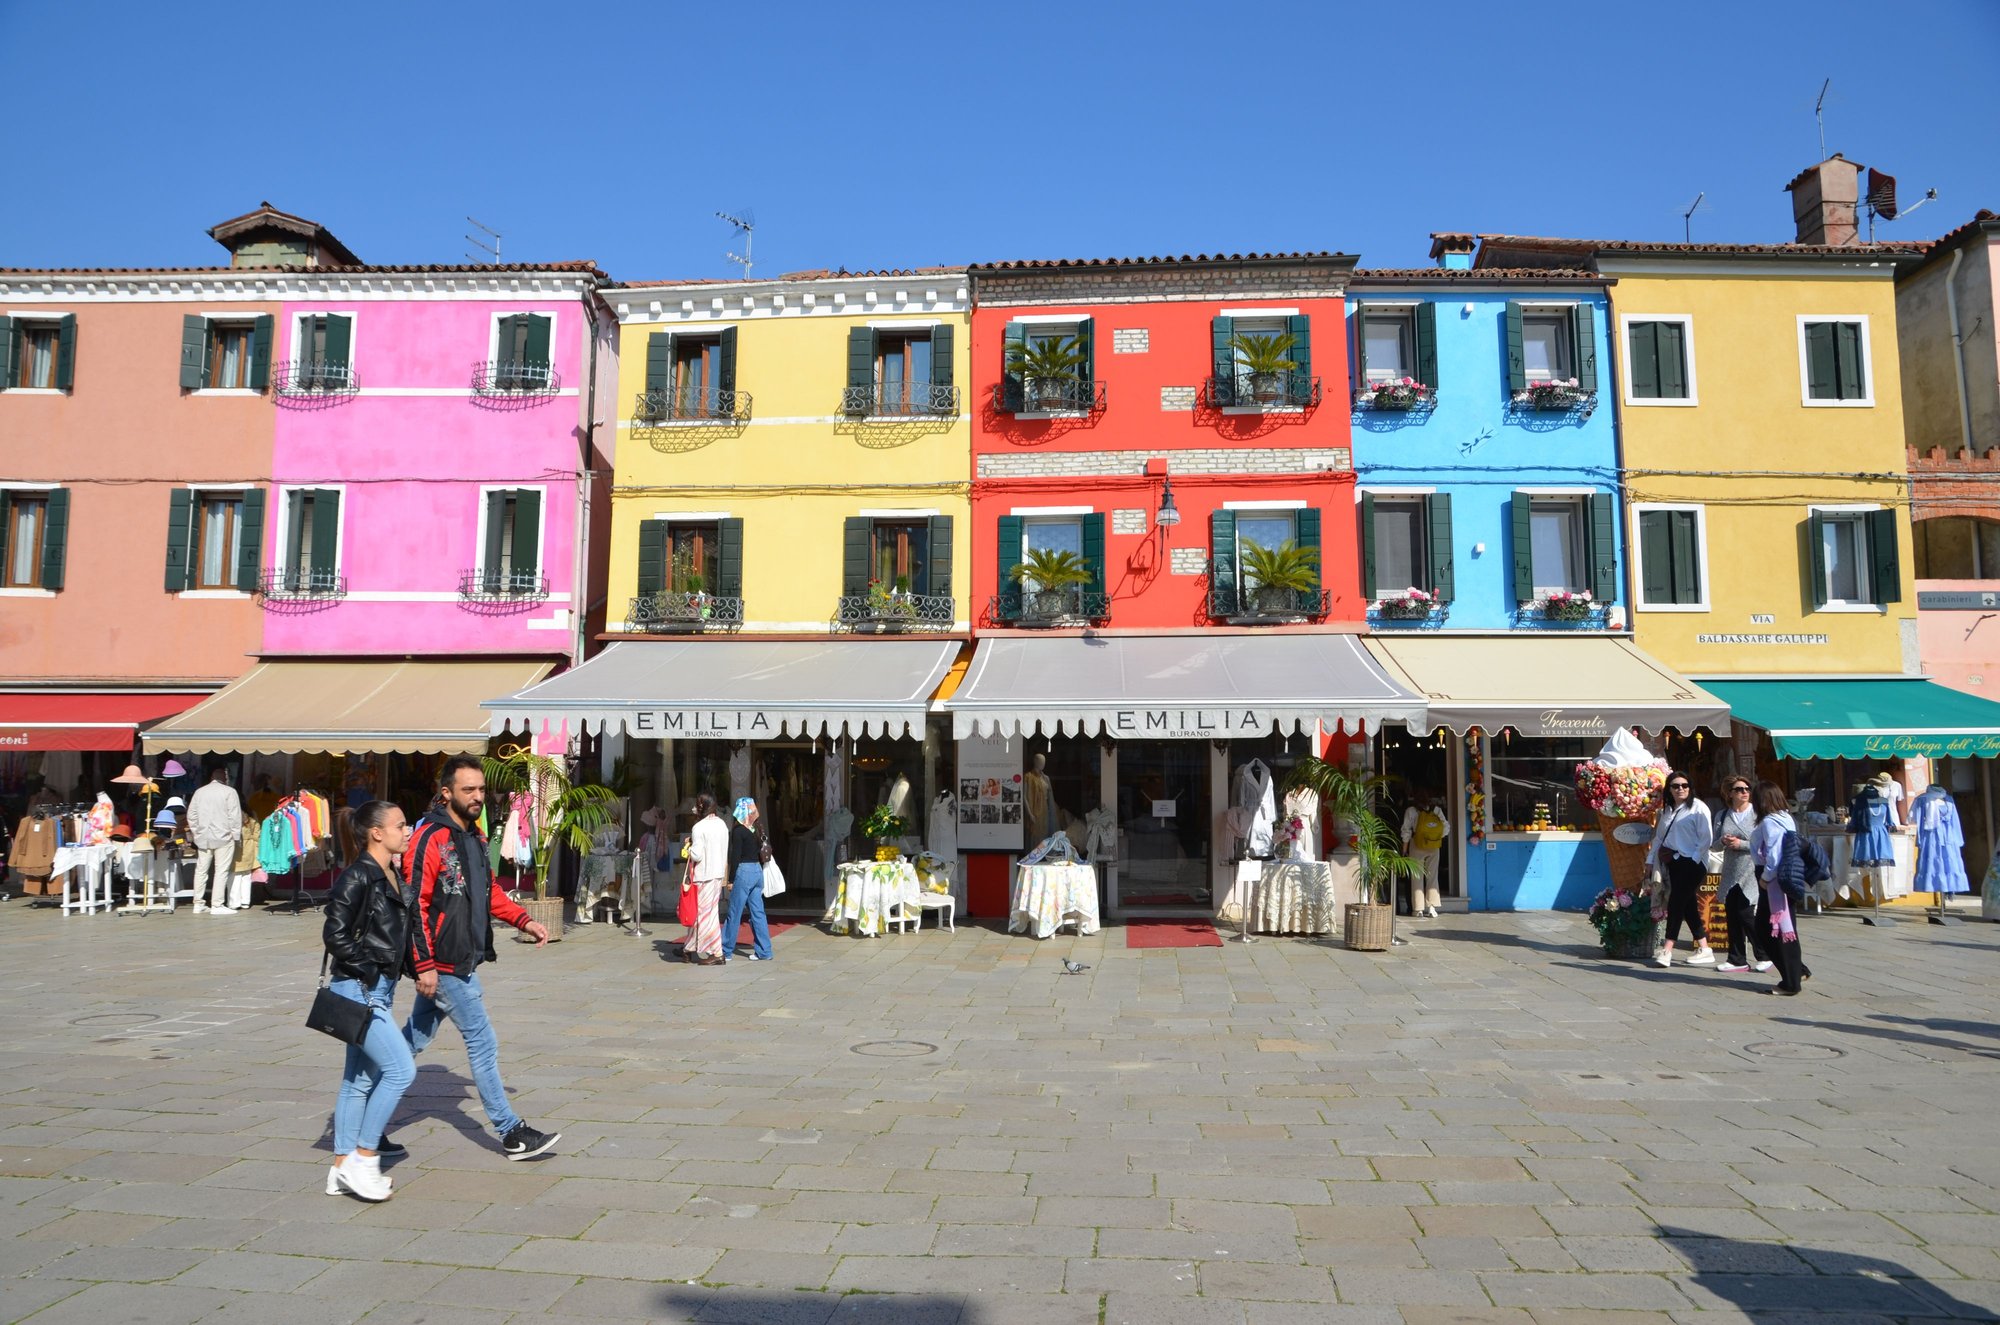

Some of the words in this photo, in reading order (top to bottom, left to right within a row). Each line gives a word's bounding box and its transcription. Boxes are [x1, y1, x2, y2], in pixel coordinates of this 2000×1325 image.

[1921, 595, 1972, 603] carabinieri
[1752, 615, 1771, 623] VIA
[1699, 634, 1772, 643] BALDASSARE
[1775, 634, 1827, 643] GALUPPI
[637, 712, 769, 730] EMILIA
[1117, 710, 1260, 730] EMILIA
[1540, 709, 1606, 728] Trexento
[1864, 735, 1889, 751] La
[1893, 735, 1942, 756] Bottega
